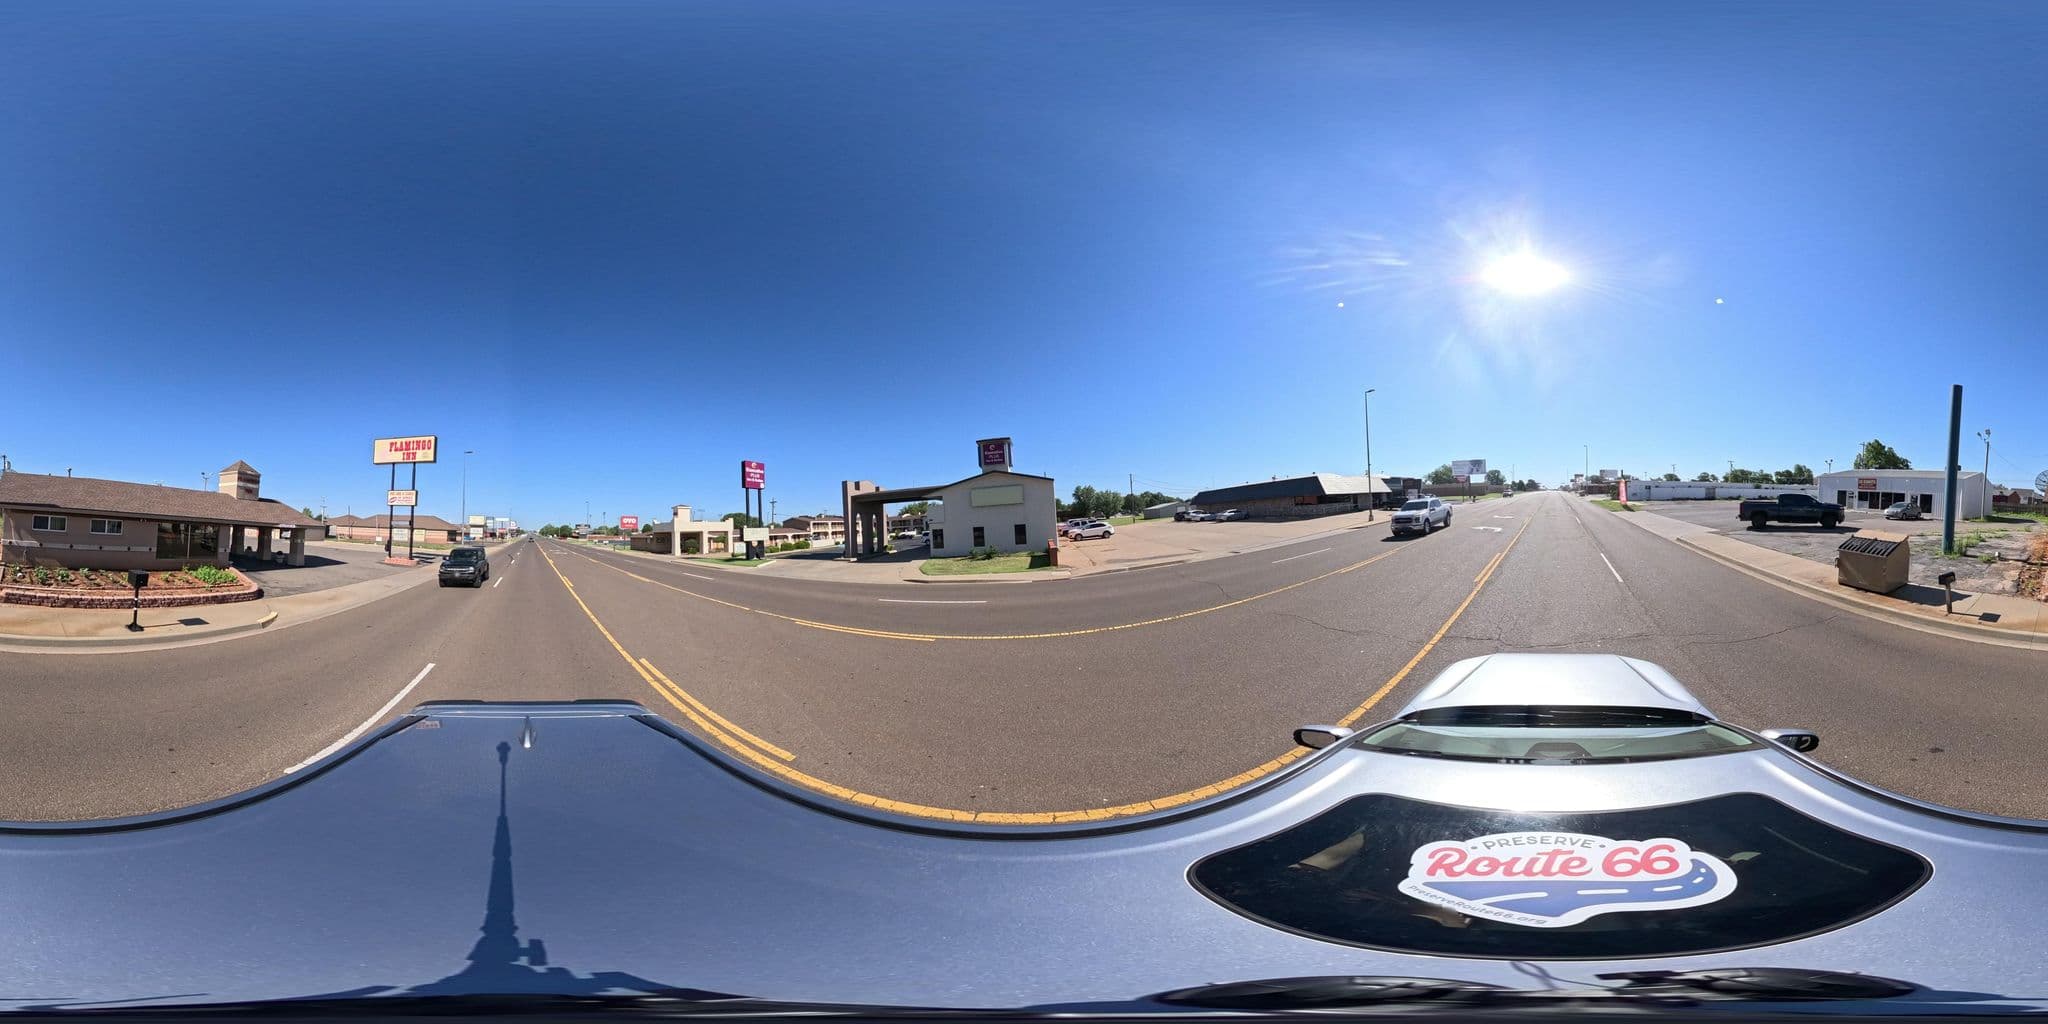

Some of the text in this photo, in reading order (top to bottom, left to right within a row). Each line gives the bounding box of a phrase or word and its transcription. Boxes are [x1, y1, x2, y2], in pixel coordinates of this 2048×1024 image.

[389, 440, 432, 452] FLAMINGO
[402, 452, 417, 460] INN
[1483, 836, 1595, 850] PRESERVE
[1427, 844, 1679, 877] Route 66
[1408, 885, 1548, 925] PreserveRoute66.org
